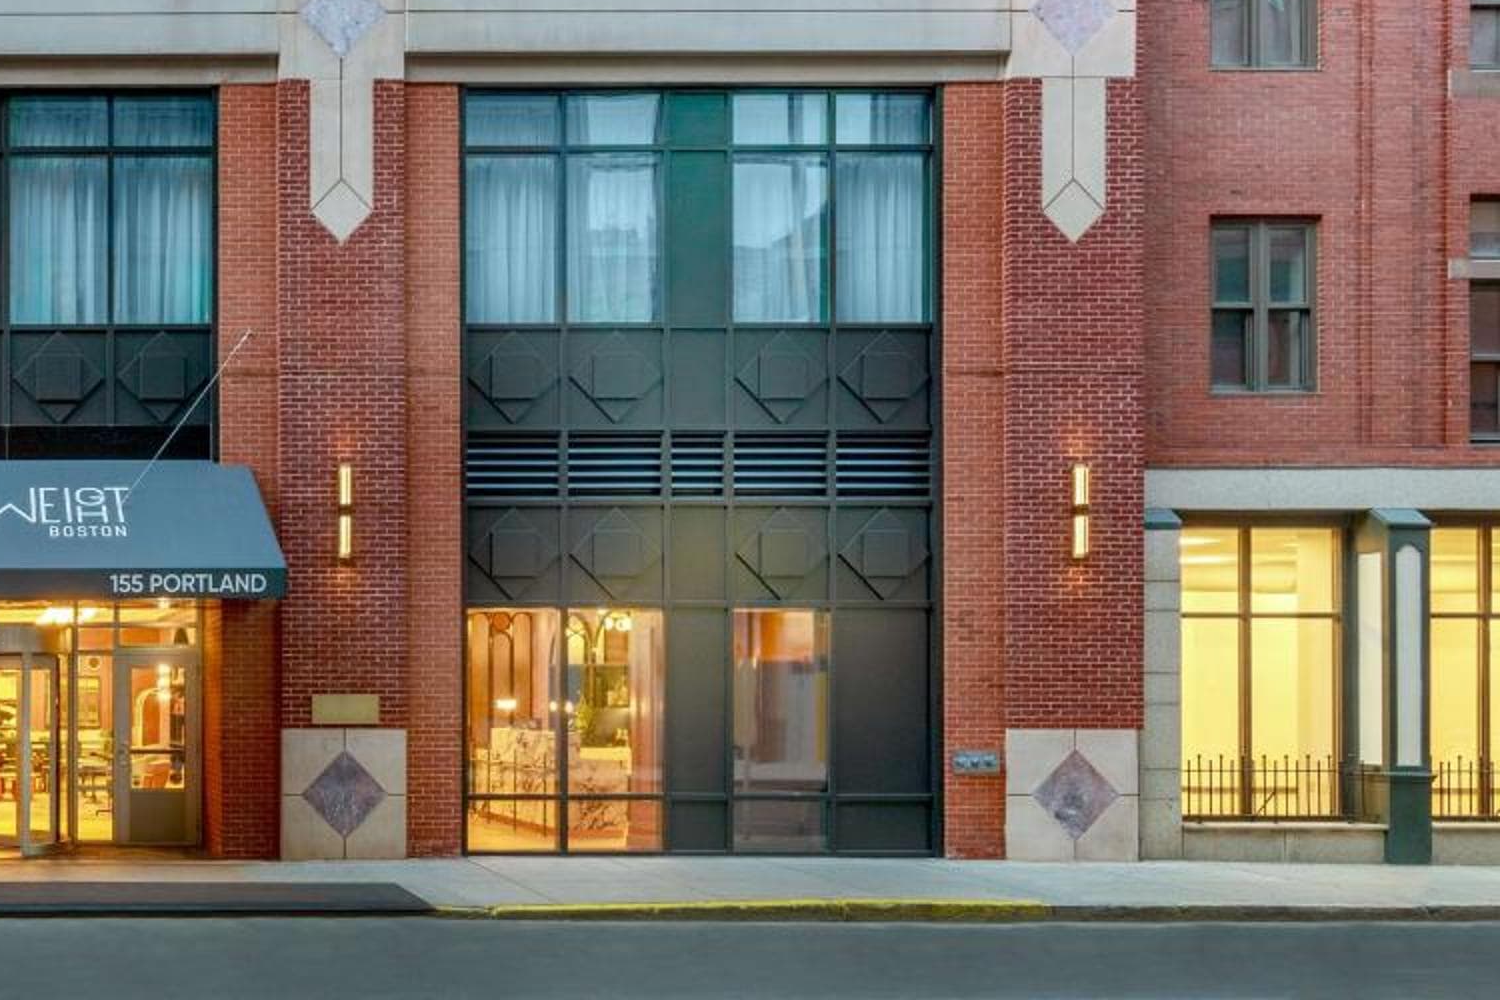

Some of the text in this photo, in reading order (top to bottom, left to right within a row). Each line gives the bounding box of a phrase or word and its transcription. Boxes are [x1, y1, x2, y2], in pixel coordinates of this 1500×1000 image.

[49, 525, 128, 537] BOSTON
[109, 573, 267, 593] 155 PORTLAND
